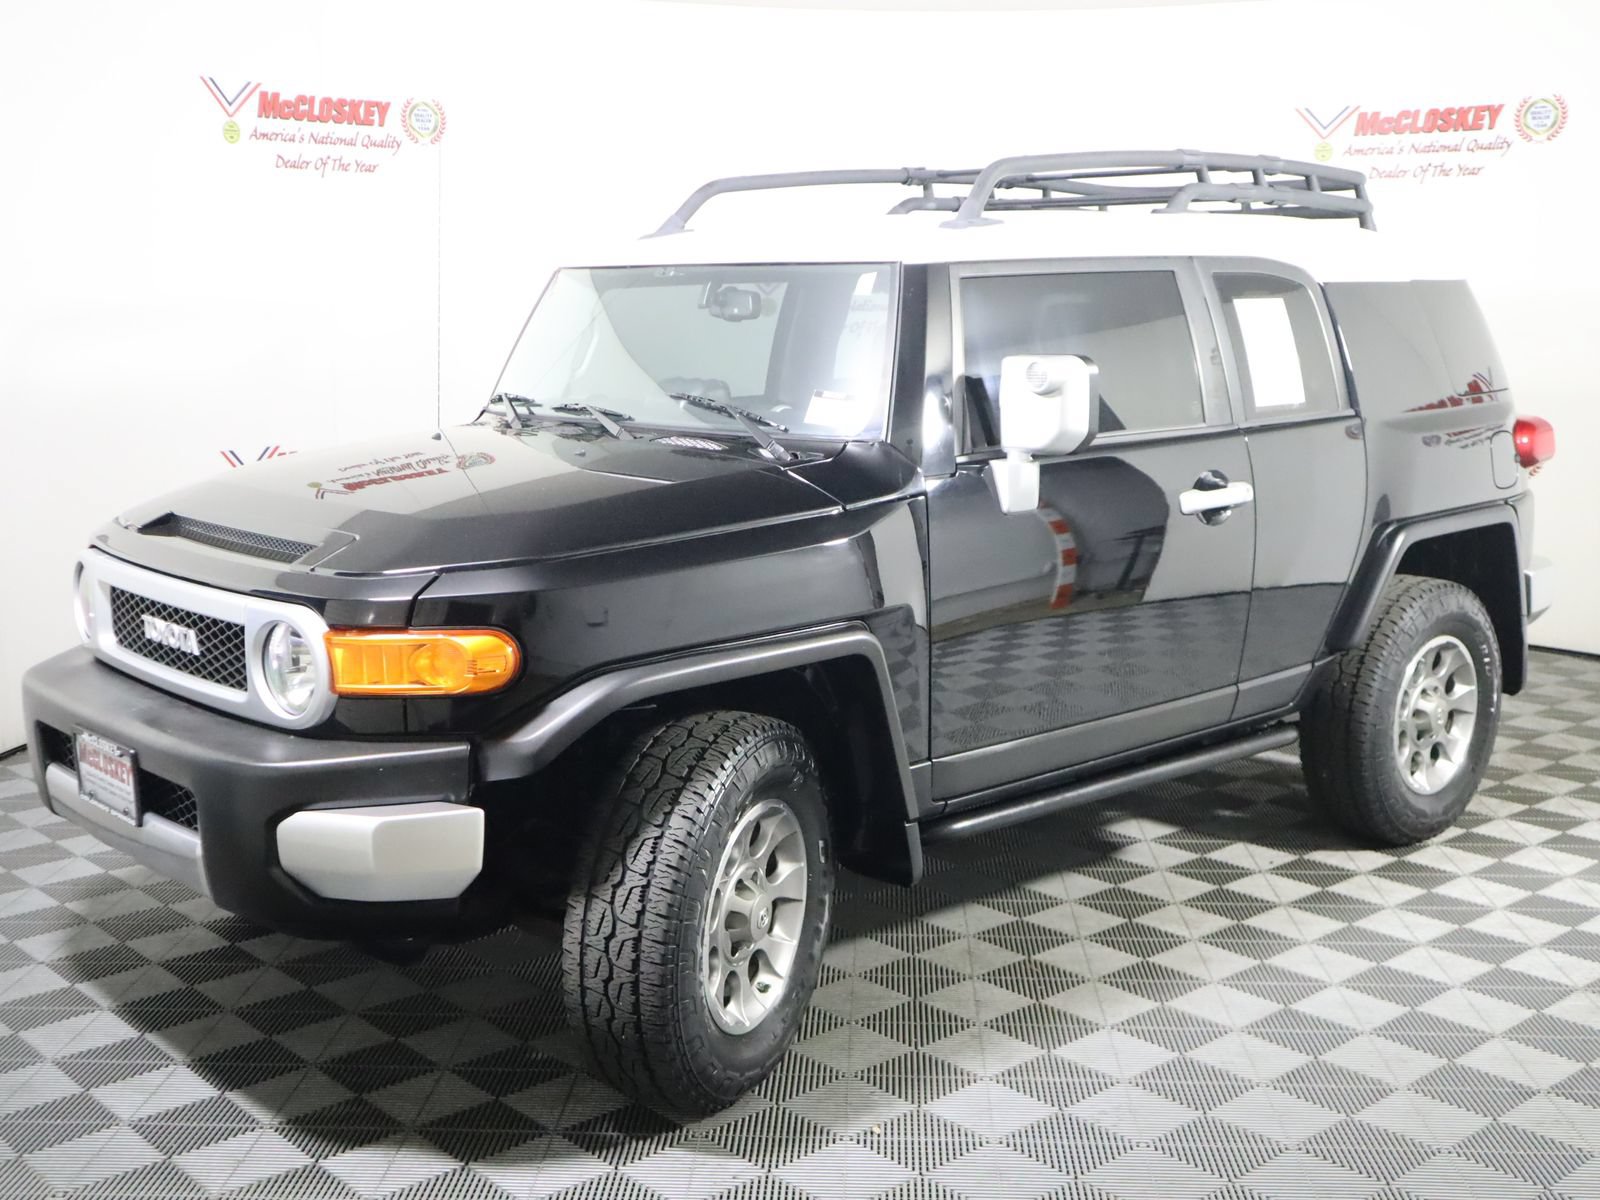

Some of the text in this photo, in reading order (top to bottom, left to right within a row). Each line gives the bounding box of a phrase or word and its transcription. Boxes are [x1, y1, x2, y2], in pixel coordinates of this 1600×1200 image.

[258, 91, 391, 127] McCLOSKEY
[1354, 104, 1504, 136] McCLOSKEY
[249, 125, 305, 144] America's
[308, 131, 359, 147] National
[361, 135, 402, 156] Quality
[1343, 139, 1405, 156] America's
[1409, 137, 1463, 155] National
[1466, 135, 1513, 158] Quality
[275, 154, 379, 177] Dealer Of The Year
[1368, 161, 1485, 184] Dealer Of The Year
